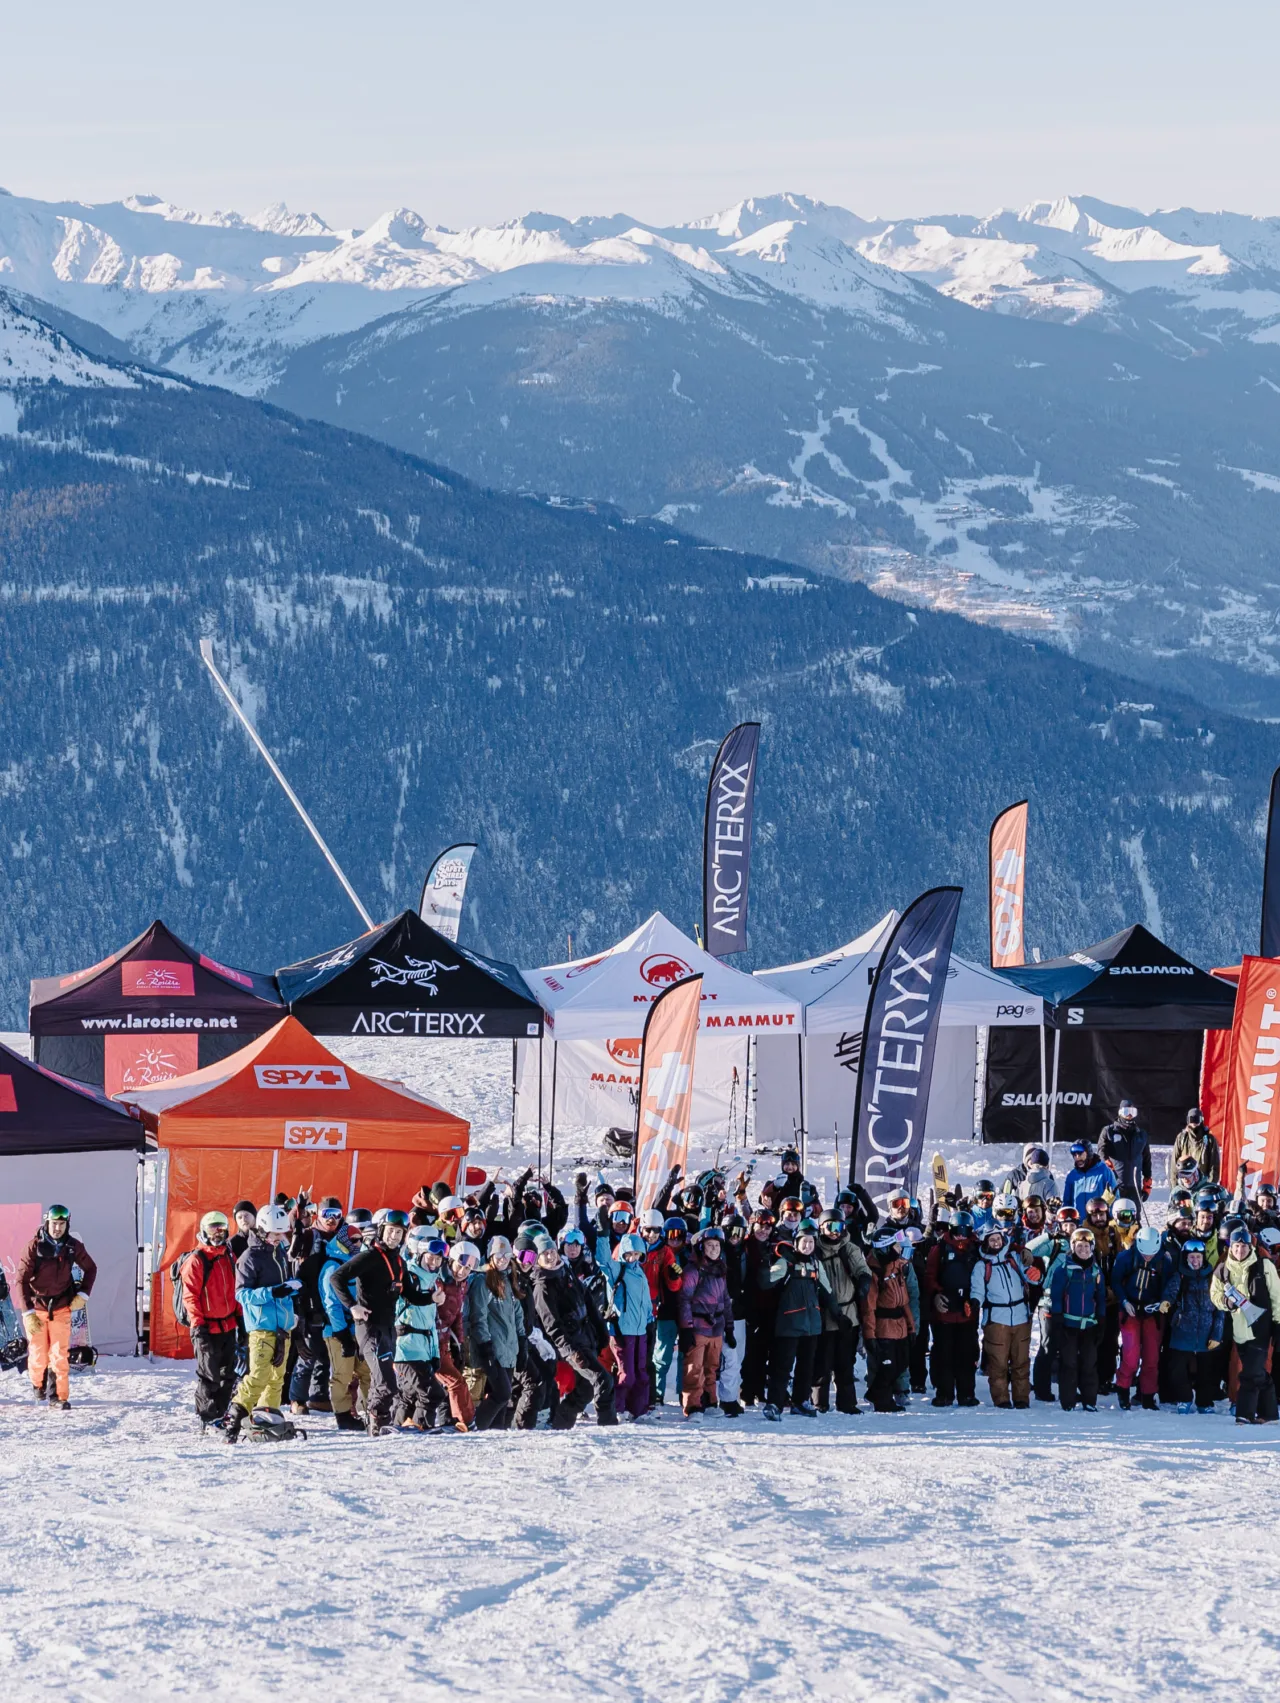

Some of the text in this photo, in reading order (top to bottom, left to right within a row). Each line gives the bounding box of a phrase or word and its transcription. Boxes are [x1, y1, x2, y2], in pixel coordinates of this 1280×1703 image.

[711, 761, 749, 936] ARC'TERYX
[1109, 965, 1194, 976] SALOMON
[81, 1012, 238, 1030] www.larosiere.net
[351, 1010, 486, 1035] ARC'TERYX
[706, 1014, 796, 1028] MAMMUT
[1001, 1091, 1093, 1106] SALOMON
